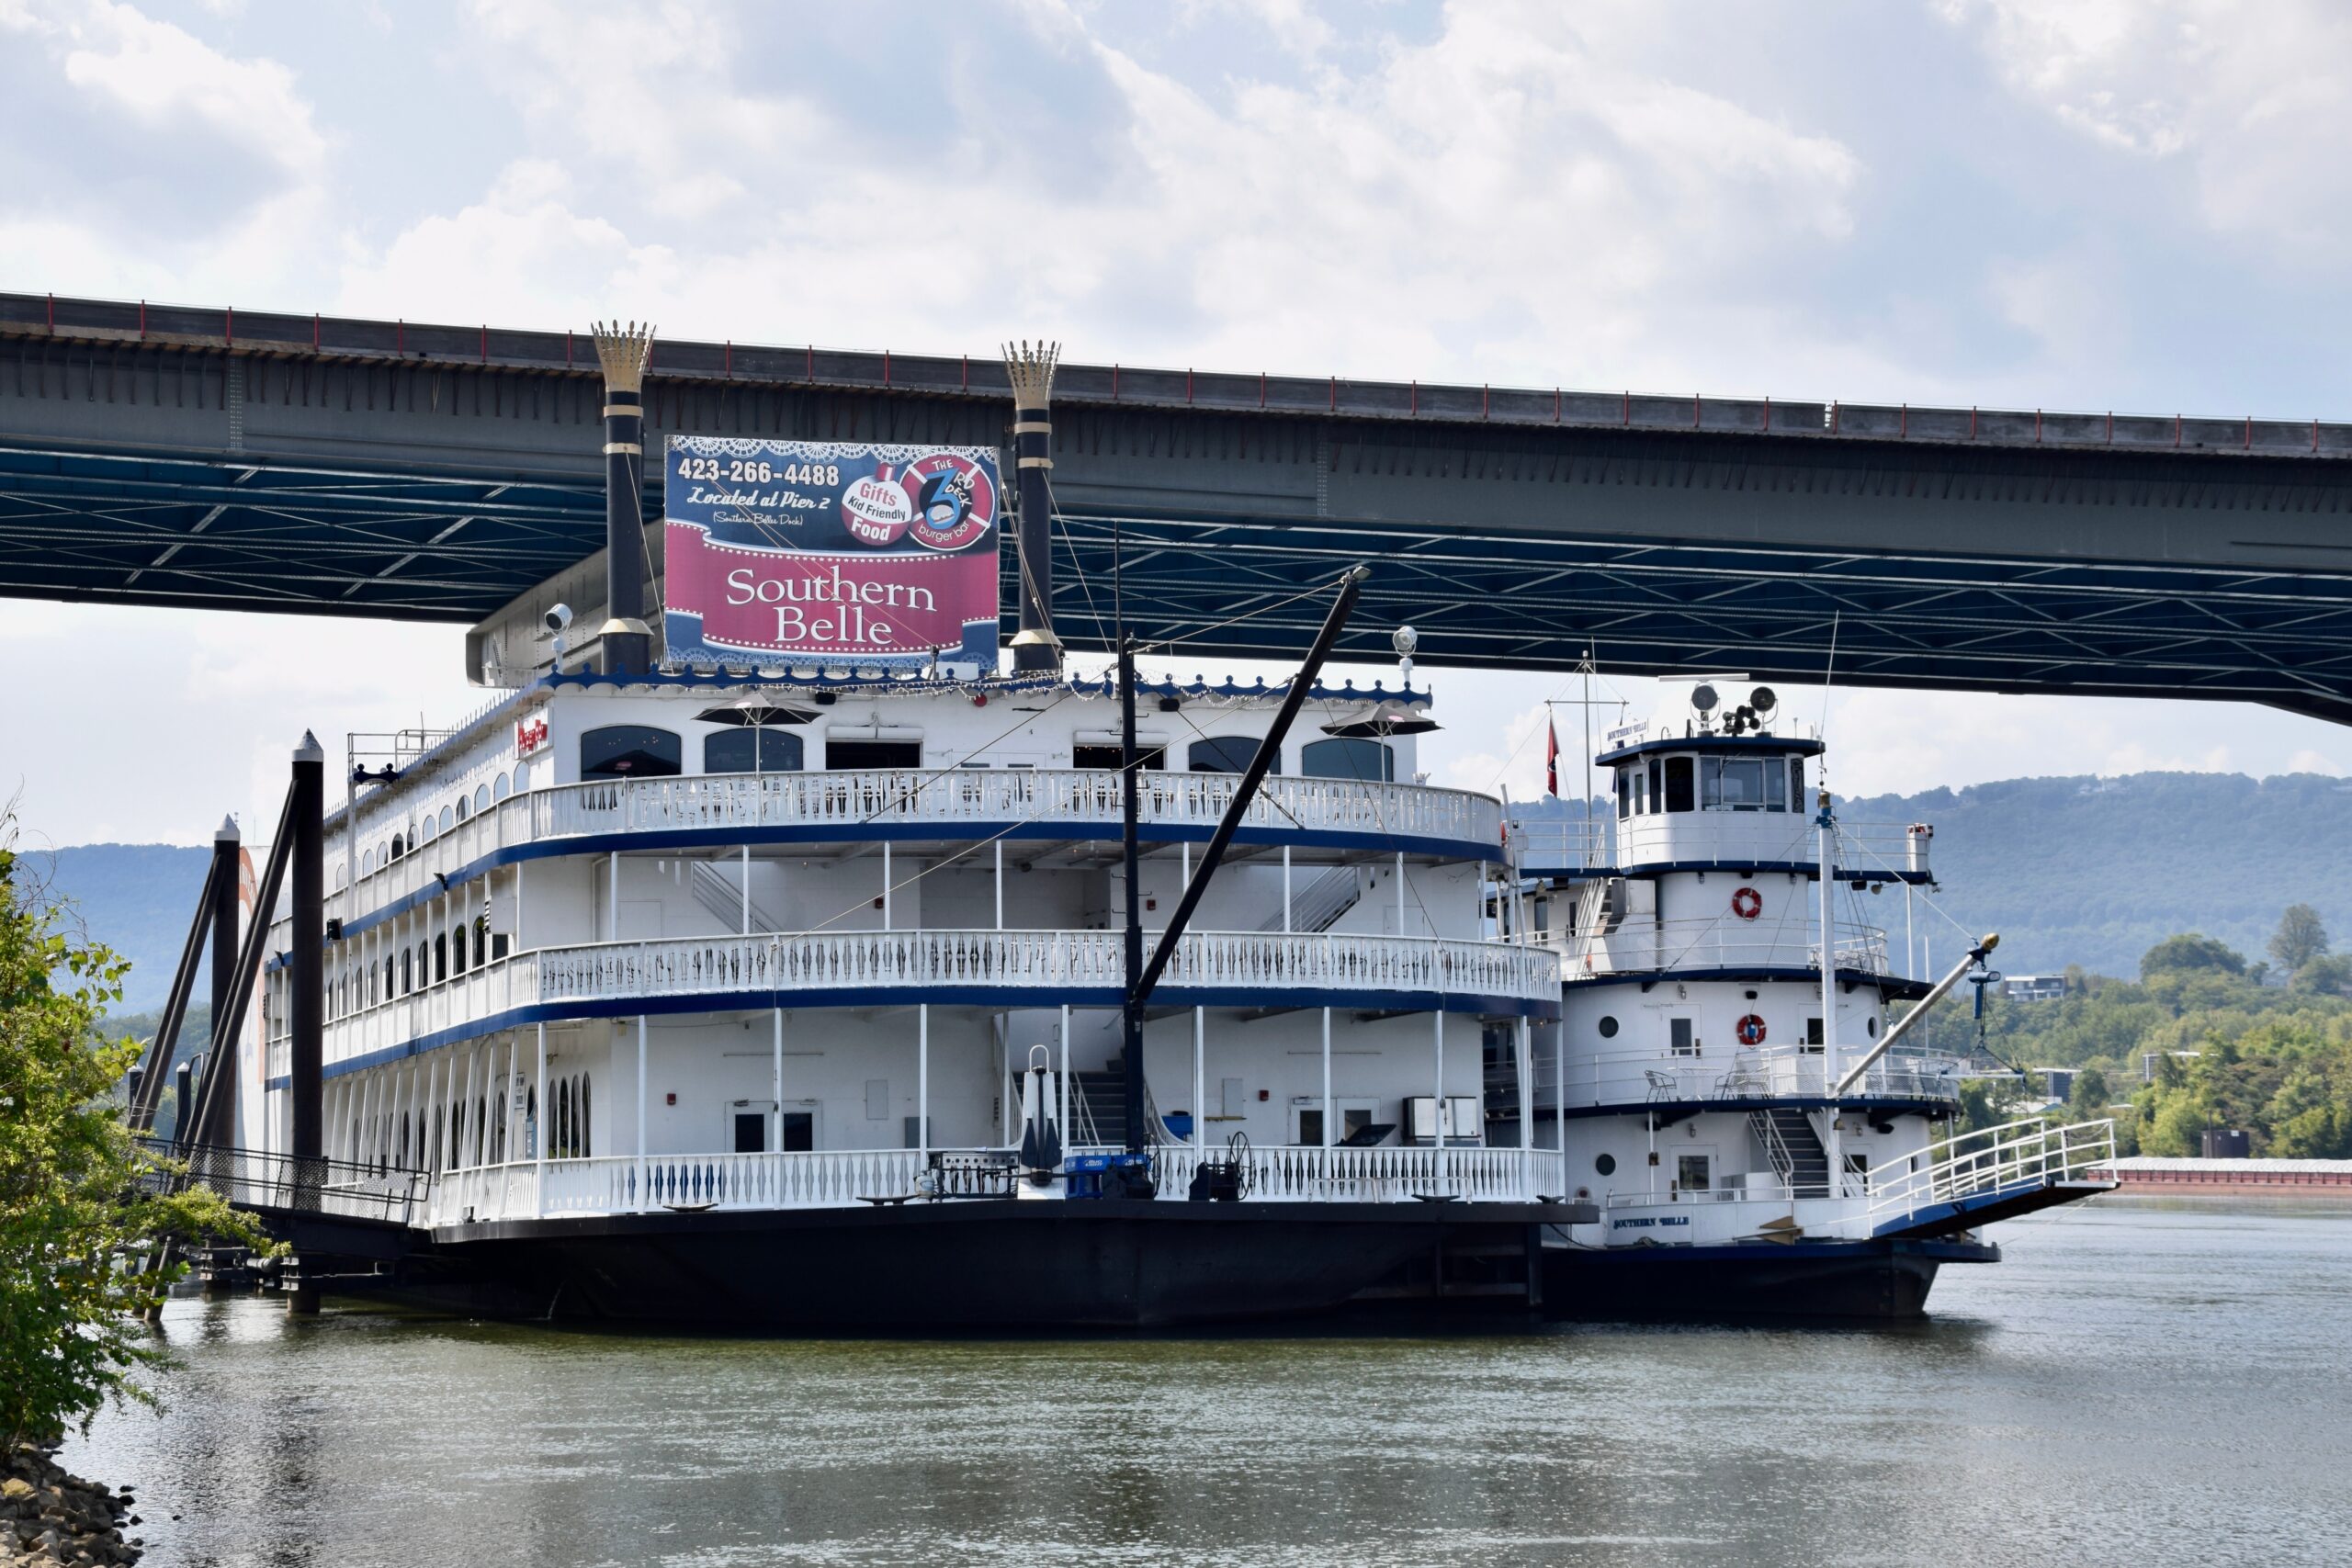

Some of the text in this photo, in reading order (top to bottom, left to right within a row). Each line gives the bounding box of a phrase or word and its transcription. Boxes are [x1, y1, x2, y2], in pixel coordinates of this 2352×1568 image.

[678, 457, 840, 486] 423-266-4488
[932, 459, 954, 471] THE
[687, 487, 831, 509] Located at Pier 2
[860, 482, 897, 506] Gifts
[944, 483, 973, 507] DECK
[780, 514, 804, 526] Dock)
[848, 496, 906, 522] Kid Friendly
[851, 515, 891, 541] Food
[919, 520, 969, 543] burger bar
[726, 565, 937, 612] Southern
[773, 604, 893, 645] Belle
[1613, 1216, 1690, 1230] SOUTHERN BELLE
